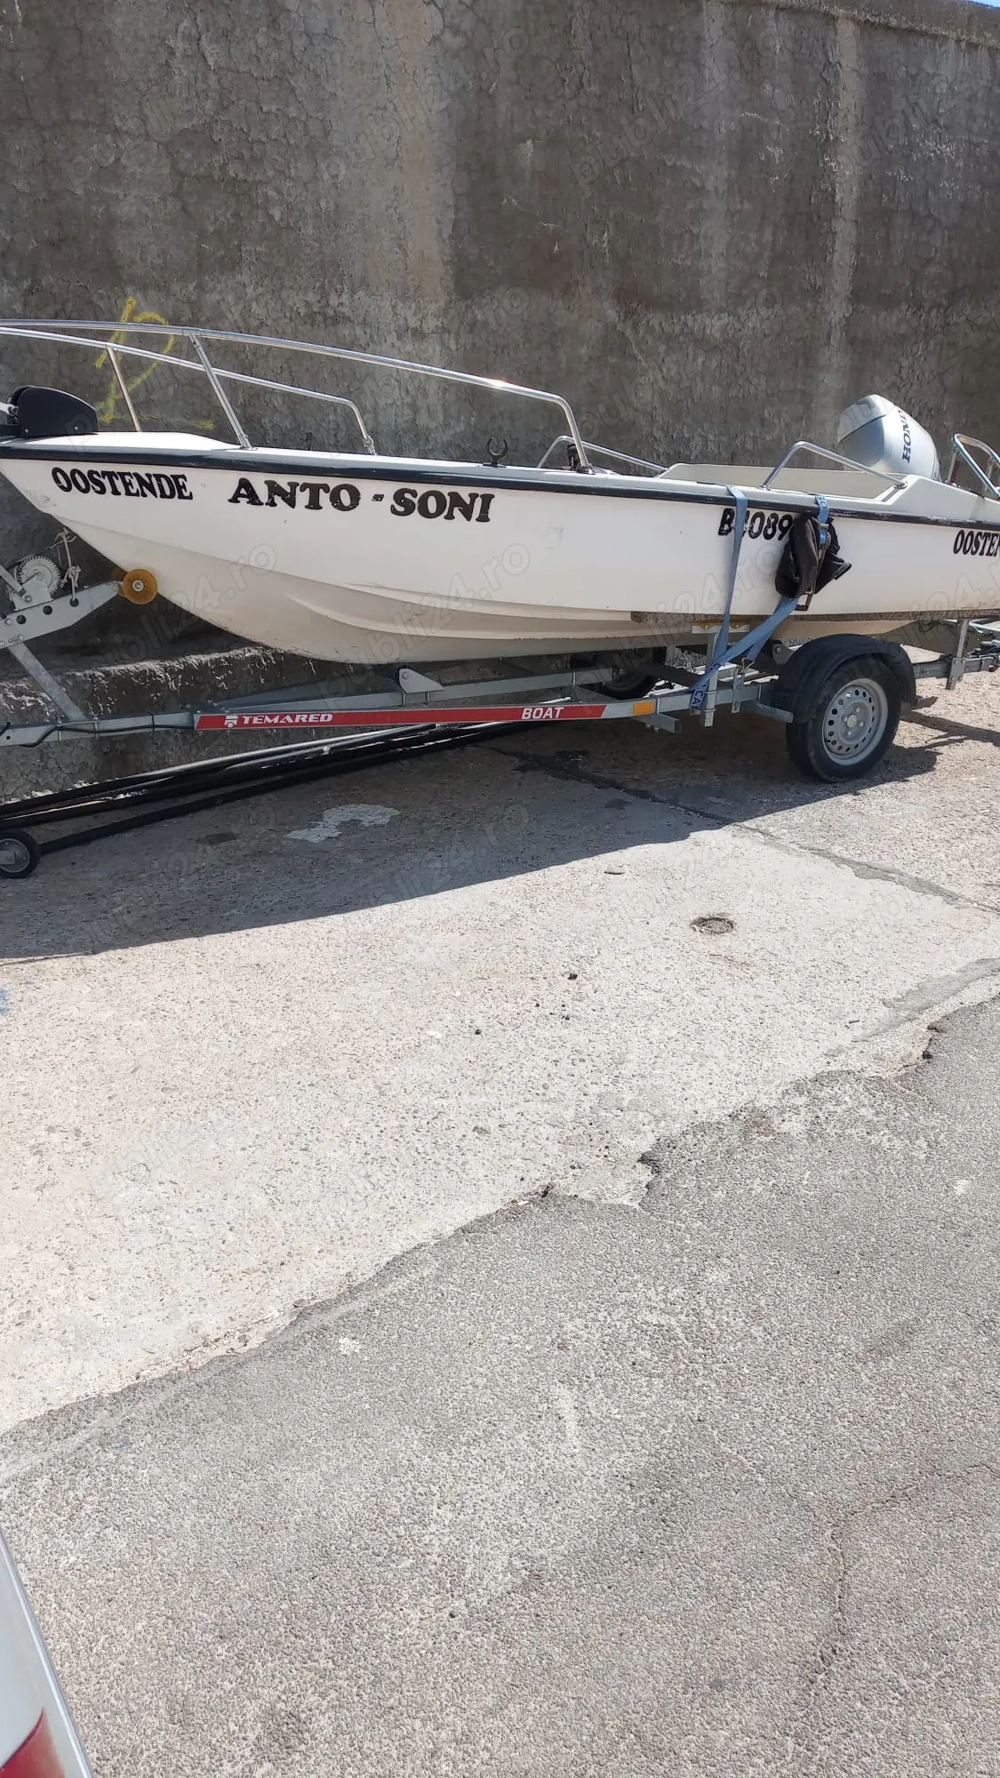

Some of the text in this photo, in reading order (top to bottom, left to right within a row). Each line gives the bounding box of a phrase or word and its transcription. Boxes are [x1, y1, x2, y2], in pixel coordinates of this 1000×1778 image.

[51, 467, 193, 500] OOSTENDE
[228, 477, 361, 512] ANTO
[390, 487, 495, 523] SONI
[718, 507, 793, 541] B089
[241, 713, 333, 725] TEMARED
[521, 706, 564, 720] BOAT
